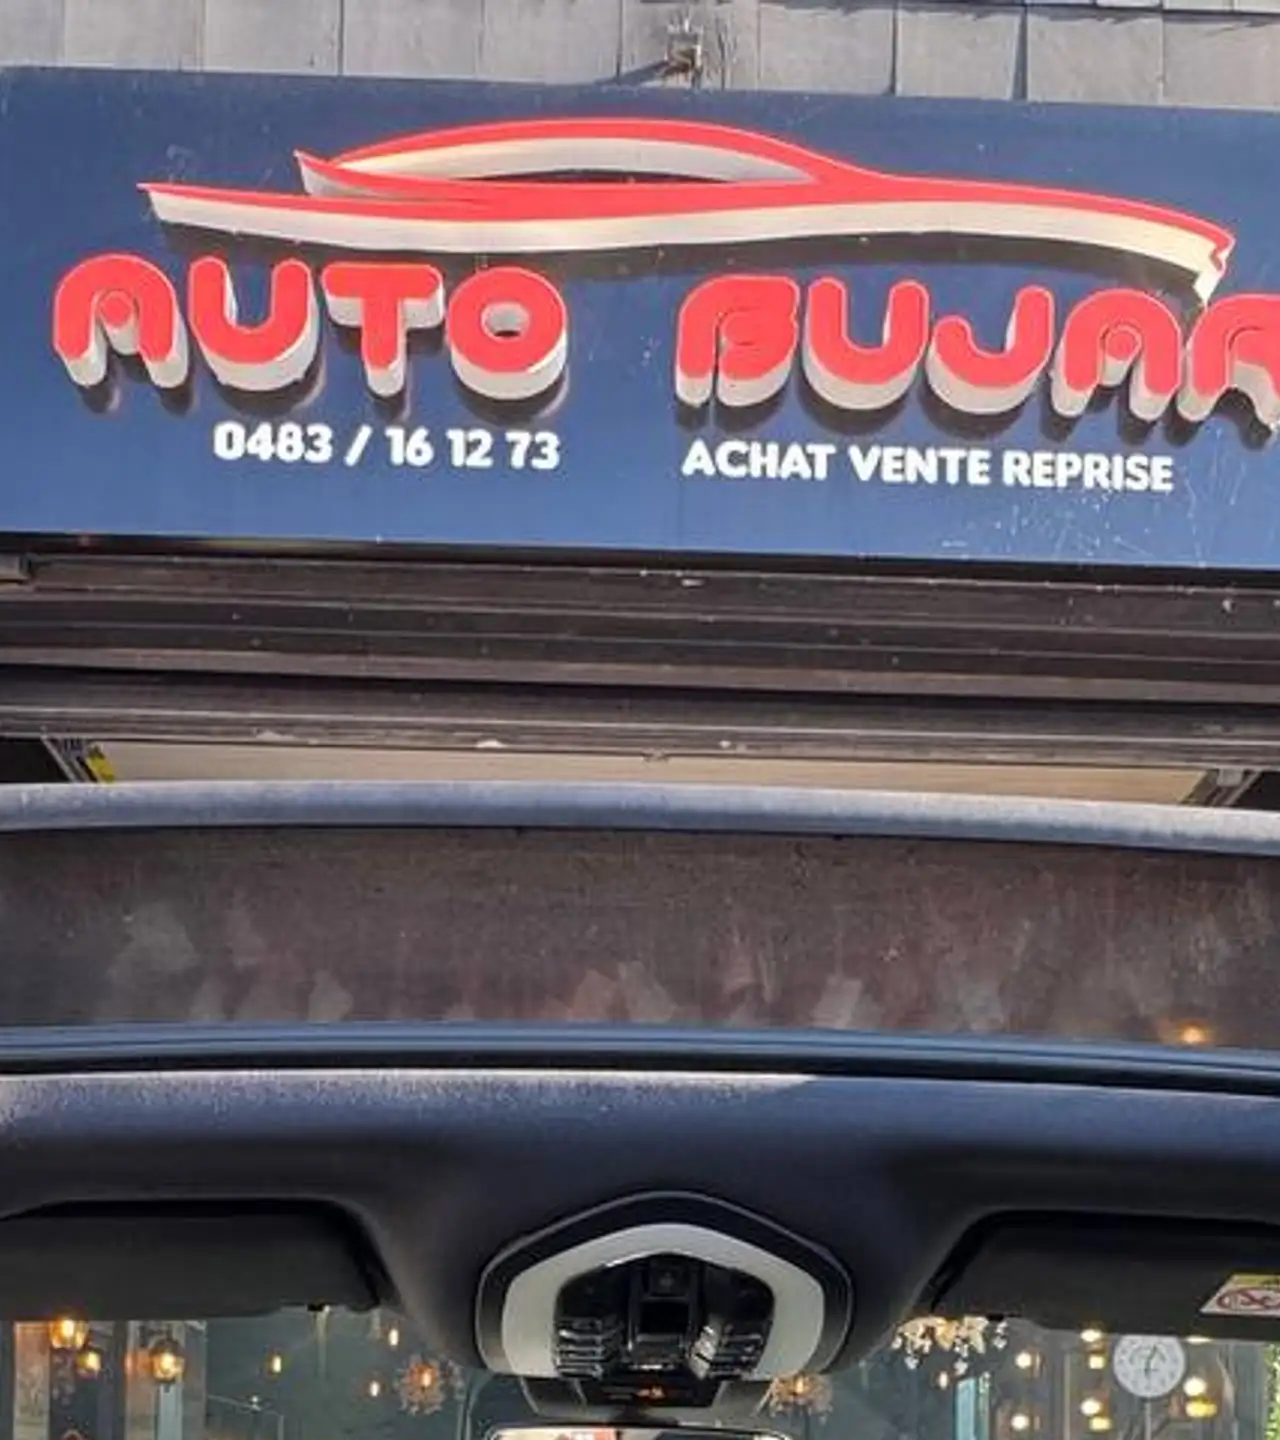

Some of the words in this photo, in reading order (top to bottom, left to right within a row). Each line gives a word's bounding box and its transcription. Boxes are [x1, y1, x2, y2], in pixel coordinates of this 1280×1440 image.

[53, 253, 569, 400] AUTO
[213, 422, 333, 465] 0483
[345, 427, 372, 466] /
[385, 427, 434, 467] 16
[447, 429, 493, 468] 12
[506, 431, 561, 470] 73
[682, 439, 835, 480] ACHAT
[848, 445, 991, 486] VENTE
[1003, 451, 1175, 492] REPRISE
